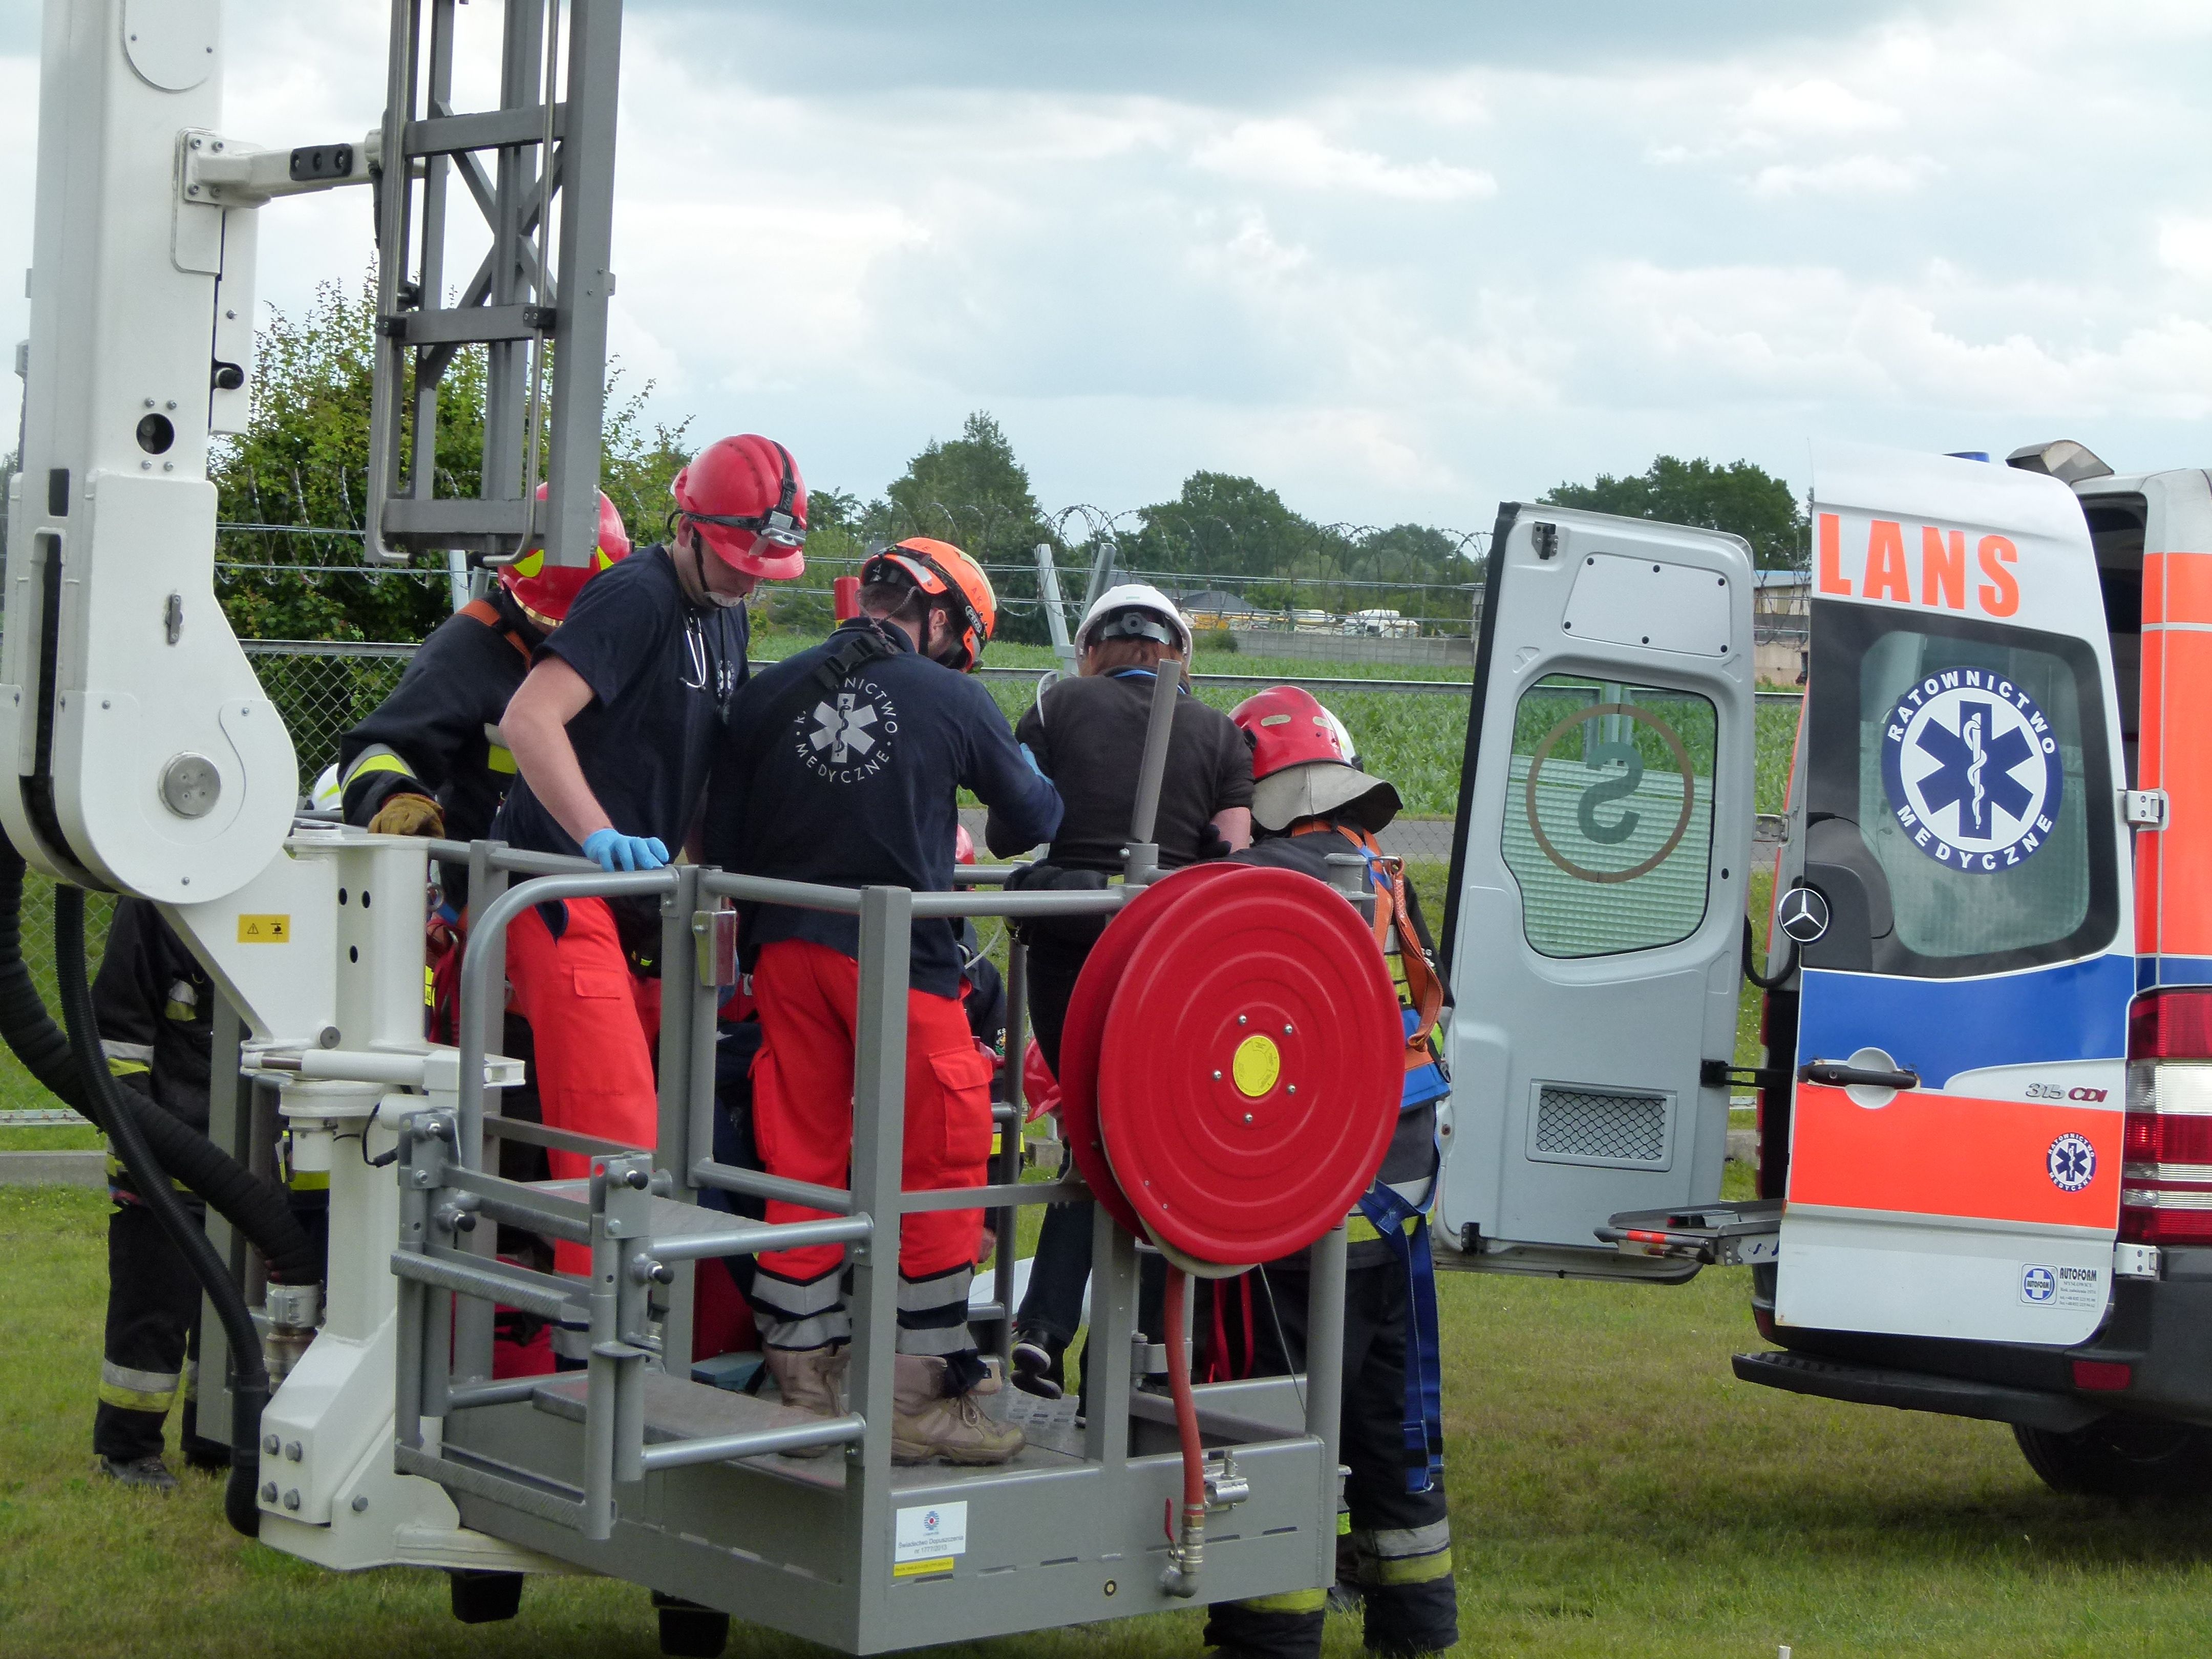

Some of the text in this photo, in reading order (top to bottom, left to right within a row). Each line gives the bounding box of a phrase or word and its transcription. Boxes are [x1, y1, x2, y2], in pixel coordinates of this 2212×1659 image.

[1819, 513, 2019, 617] LANS
[1887, 670, 2056, 755] RATOWNICTWO
[795, 743, 890, 783] MEDYCZNE
[1897, 804, 2053, 870] MEDYCZNE
[2025, 1082, 2108, 1102] 315 CDI
[2048, 1133, 2095, 1158] RATOWNICTWO
[2048, 1172, 2093, 1191] MEDYCZNE
